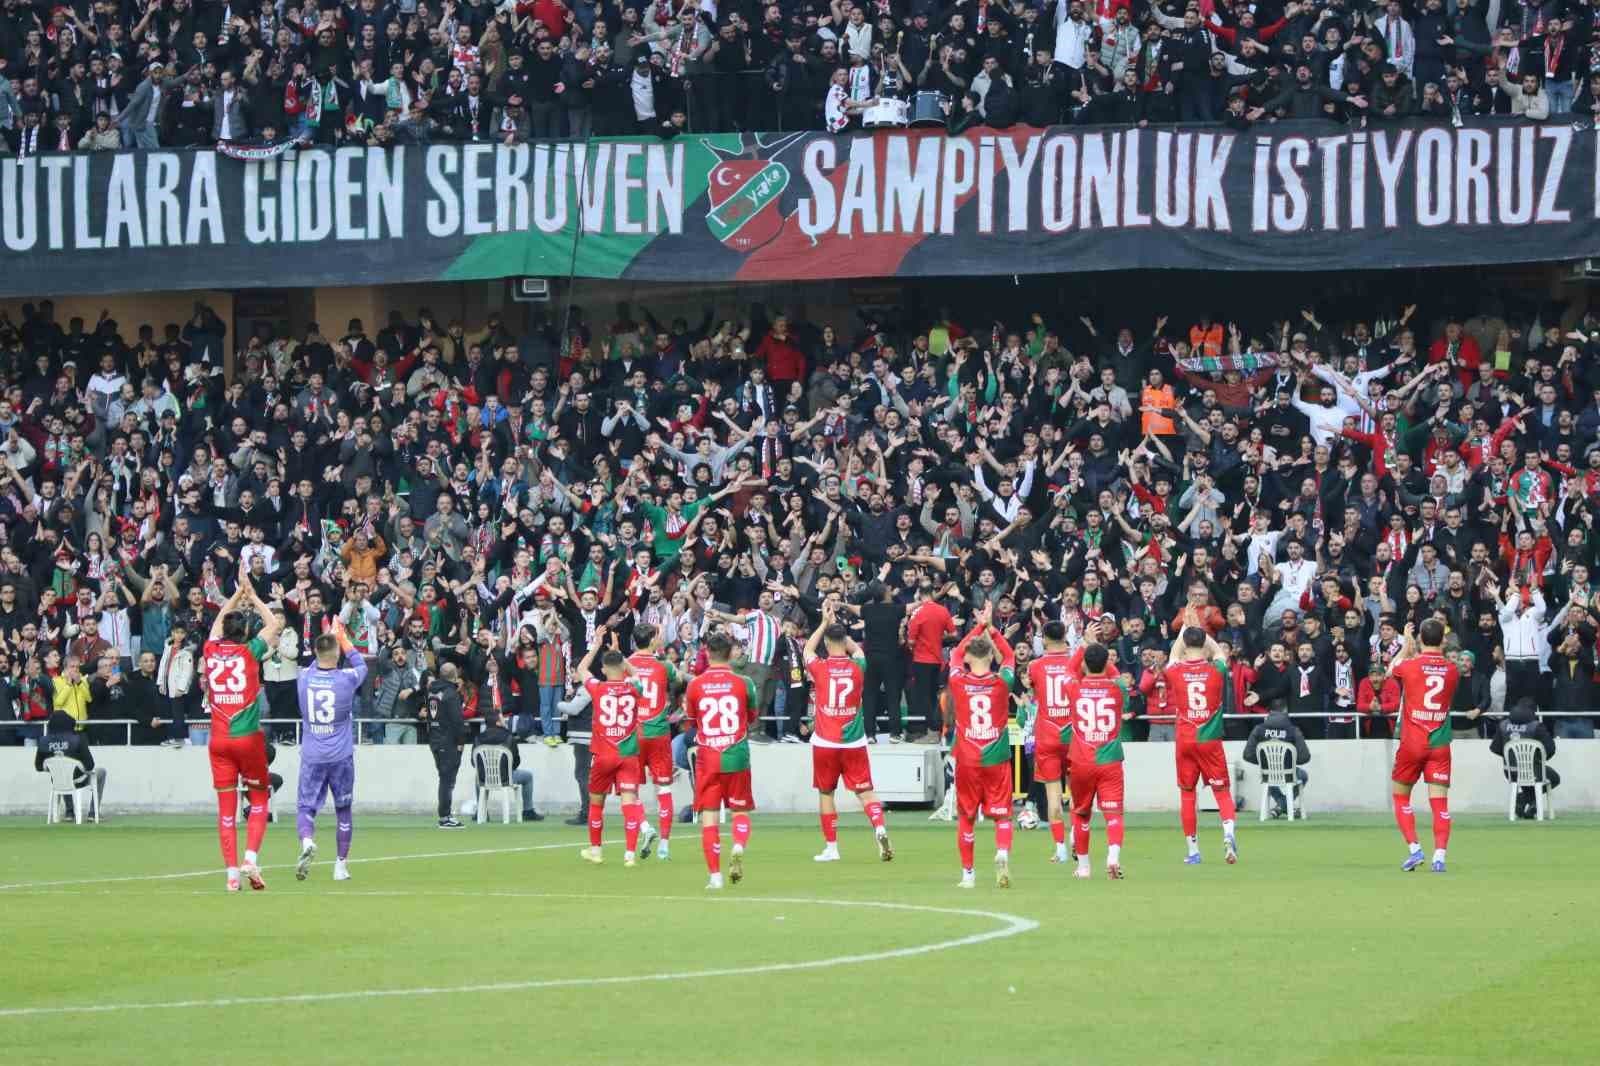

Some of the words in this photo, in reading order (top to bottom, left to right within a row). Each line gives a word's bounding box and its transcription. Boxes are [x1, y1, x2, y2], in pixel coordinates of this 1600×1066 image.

[1251, 125, 1574, 232] İSTİYORUZ
[207, 657, 247, 692] 23
[1046, 674, 1070, 707] 10
[306, 687, 336, 724] 13
[642, 677, 658, 709] 4
[828, 677, 854, 708] 17
[1187, 681, 1207, 710] 6
[1423, 675, 1445, 710] 2
[599, 694, 636, 727] 93
[699, 695, 739, 737] 28
[969, 694, 992, 730] 8
[1075, 697, 1116, 733] 95
